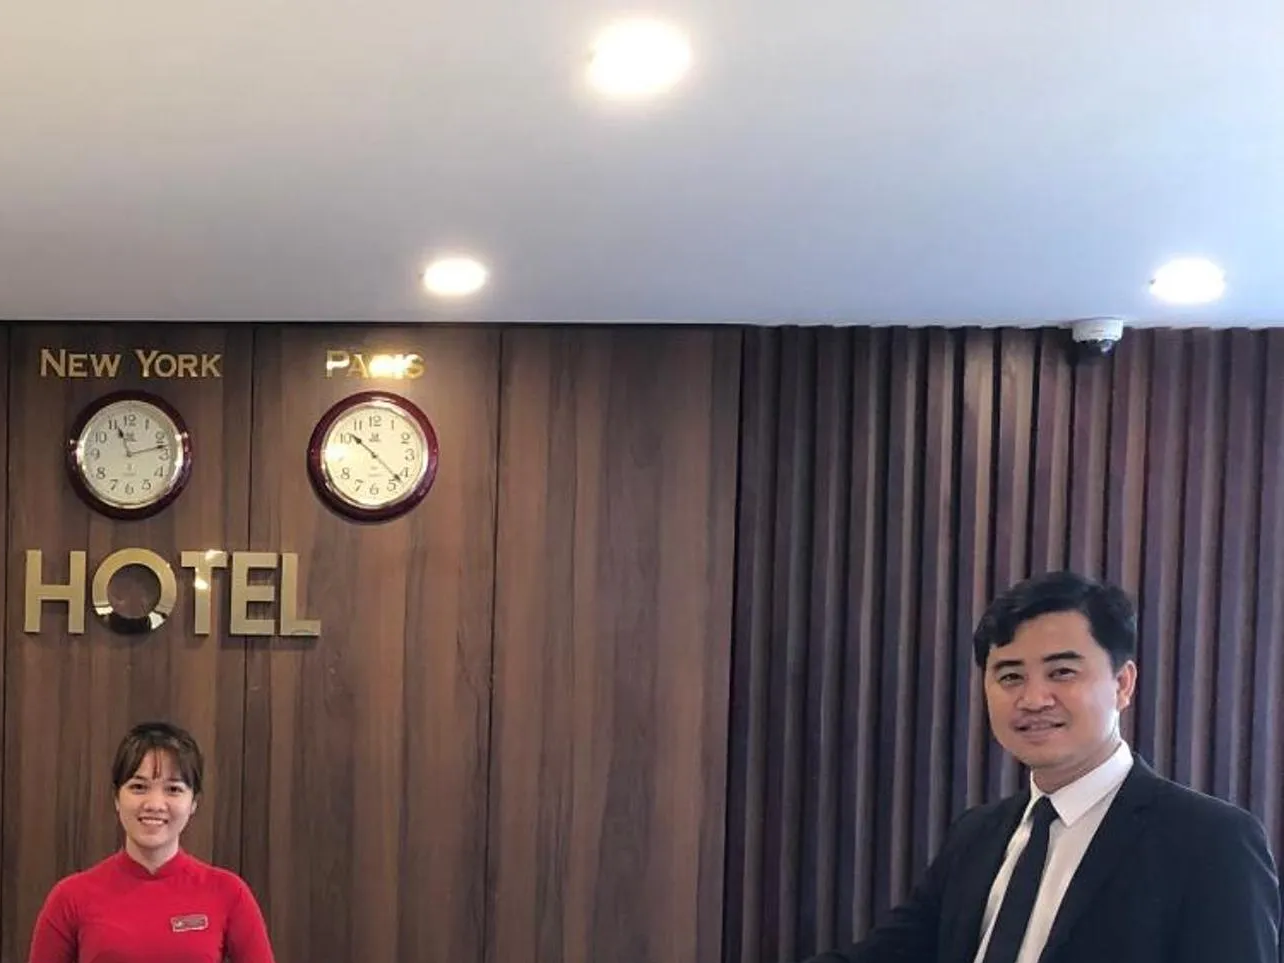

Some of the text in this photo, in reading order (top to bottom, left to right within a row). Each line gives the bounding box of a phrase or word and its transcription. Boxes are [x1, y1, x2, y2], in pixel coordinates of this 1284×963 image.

[369, 416, 382, 427] 12
[401, 433, 410, 444] 2
[405, 448, 415, 460] 3
[97, 467, 106, 479] 8
[341, 468, 349, 480] 8
[400, 466, 408, 477] 4
[370, 483, 378, 495] 6
[23, 547, 322, 637] HOTEL
